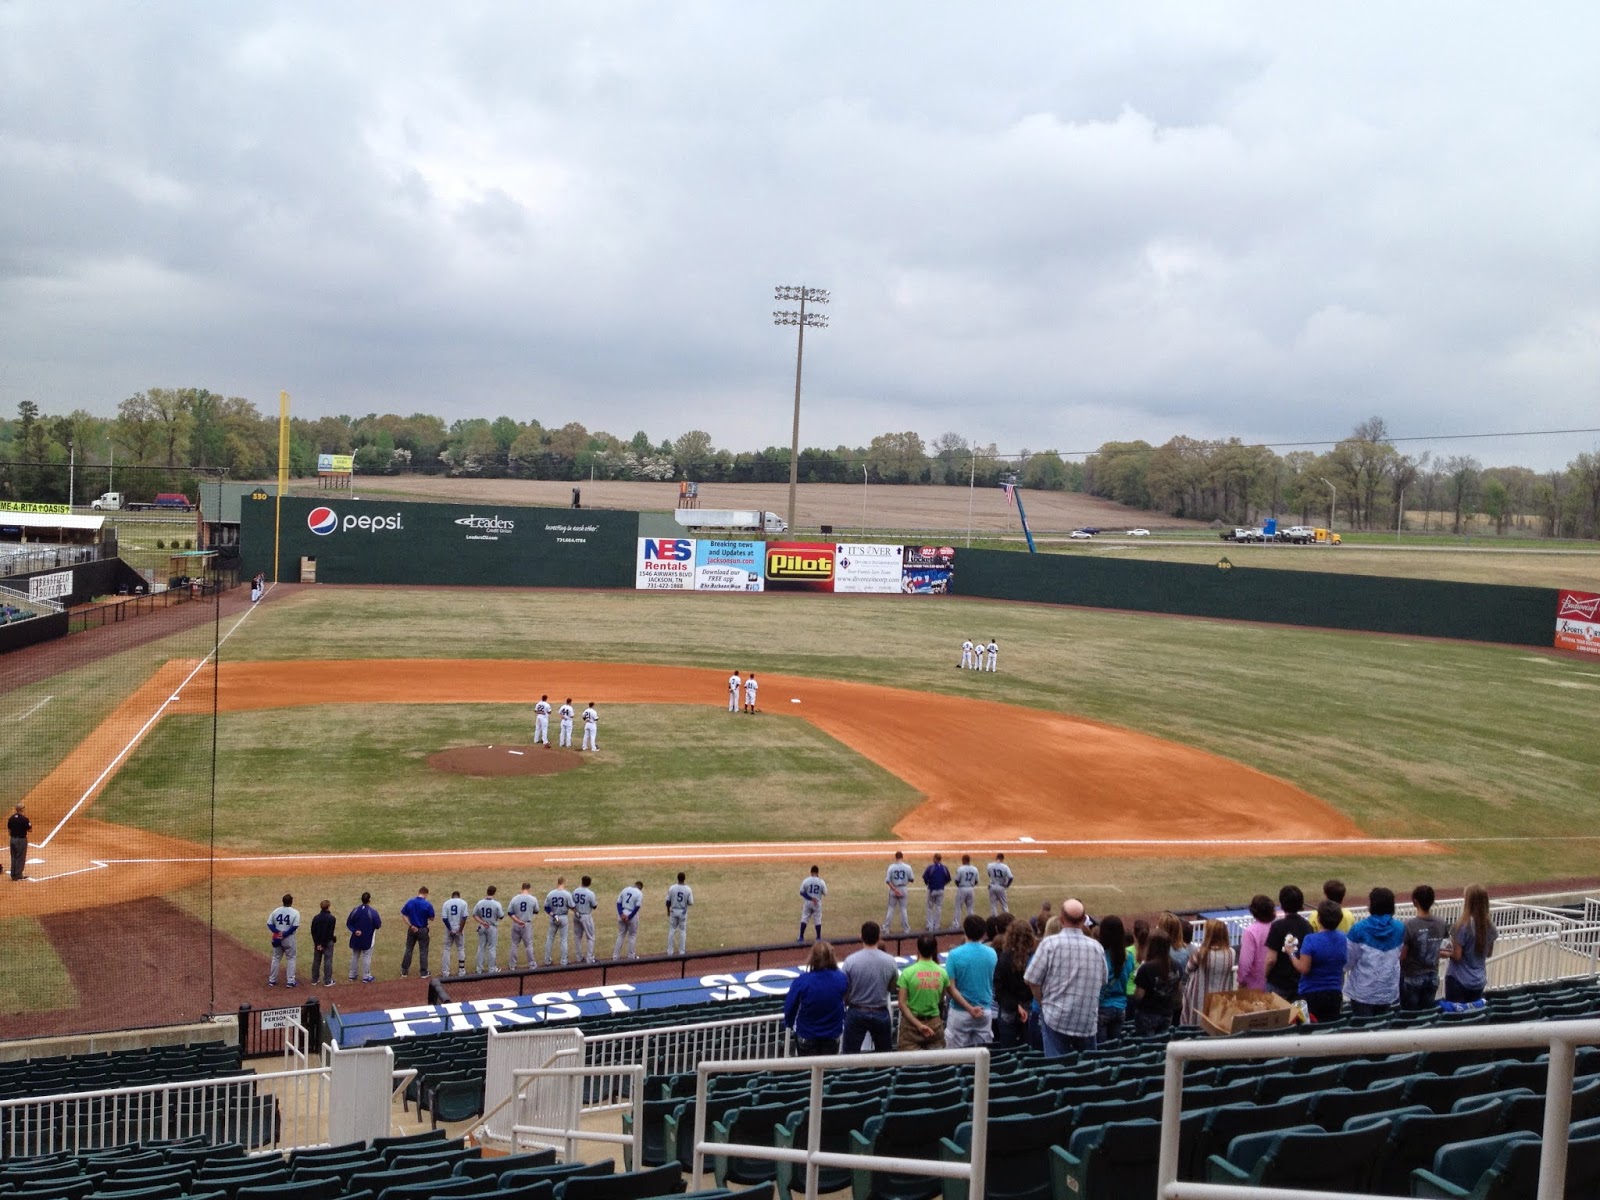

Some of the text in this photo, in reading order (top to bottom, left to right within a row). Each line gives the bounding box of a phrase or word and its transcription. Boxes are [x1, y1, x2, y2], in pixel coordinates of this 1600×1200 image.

[43, 504, 66, 514] OASIS
[343, 512, 402, 533] pepsi
[470, 514, 514, 529] Leaders
[644, 539, 692, 560] NES
[848, 546, 891, 556] IT'S OVER
[645, 562, 688, 570] Rentals
[771, 554, 832, 574] Pilot
[894, 870, 906, 880] 33
[965, 872, 974, 881] 17
[809, 884, 820, 894] 12
[575, 894, 586, 904] 35
[626, 892, 632, 904] 7
[677, 892, 684, 902] 5
[520, 902, 527, 912] 8
[552, 897, 564, 908] 23
[450, 905, 458, 916] 9
[481, 906, 492, 918] 18
[276, 914, 290, 926] 44
[264, 1008, 300, 1017] AUTHORIZED
[384, 984, 636, 1037] FIRST
[264, 1014, 298, 1022] PERSONEL
